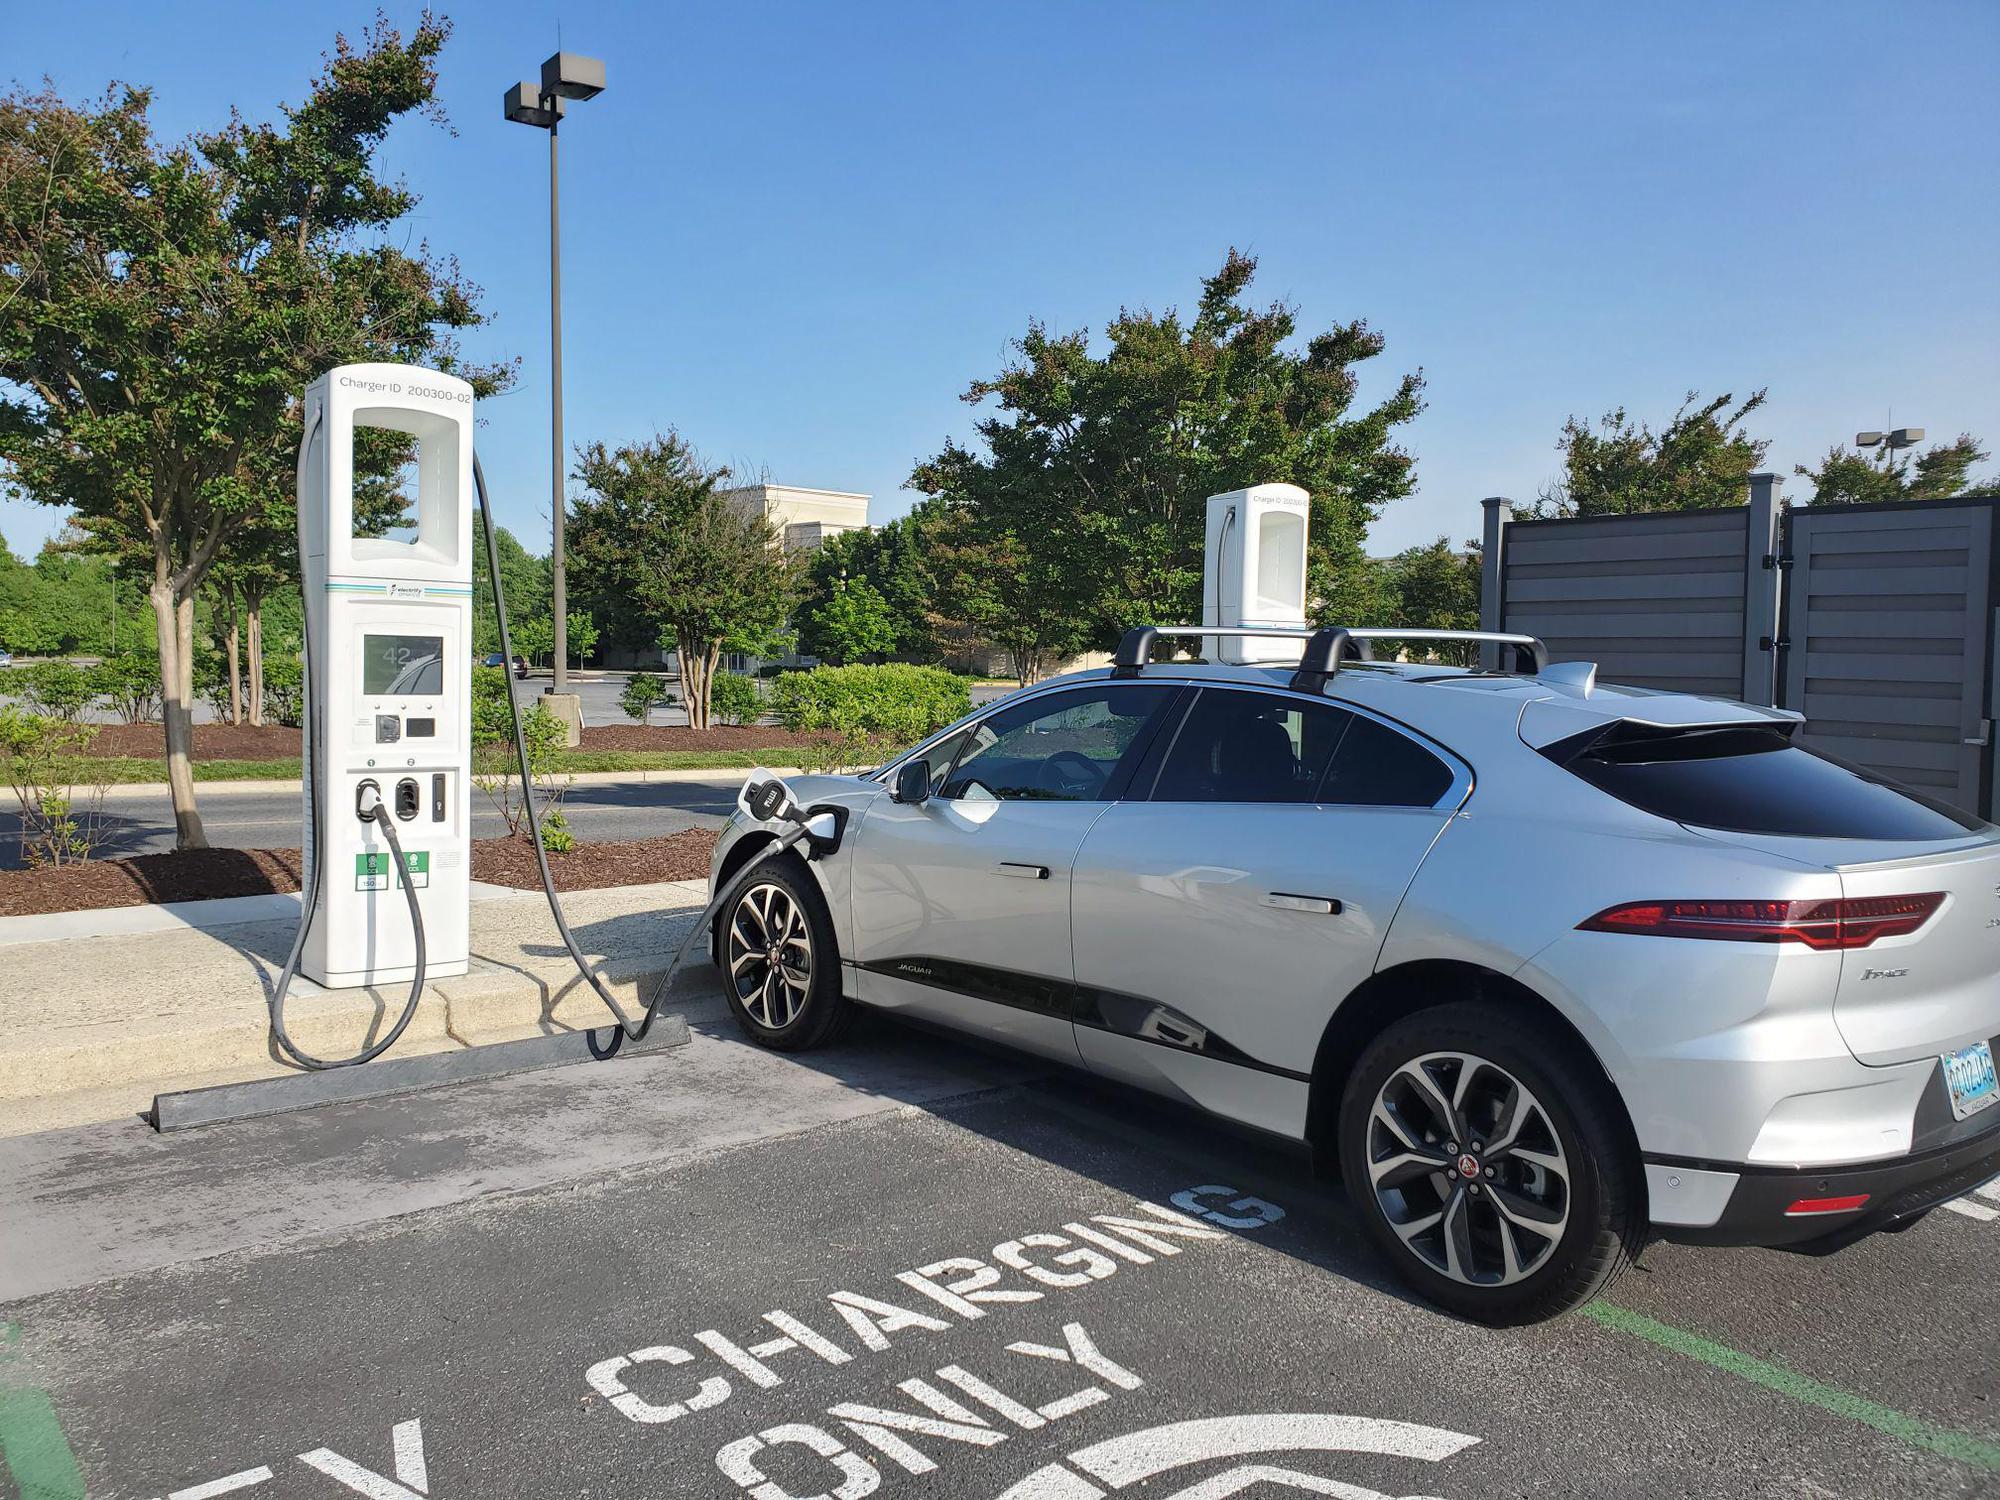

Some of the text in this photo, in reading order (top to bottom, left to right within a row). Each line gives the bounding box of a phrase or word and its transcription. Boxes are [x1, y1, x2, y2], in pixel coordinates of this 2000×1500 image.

[339, 376, 471, 404] Charger ID 200300-02
[897, 963, 933, 975] JAGUAR
[585, 1184, 1287, 1424] CHARGING
[715, 1322, 1144, 1500] ONLY
